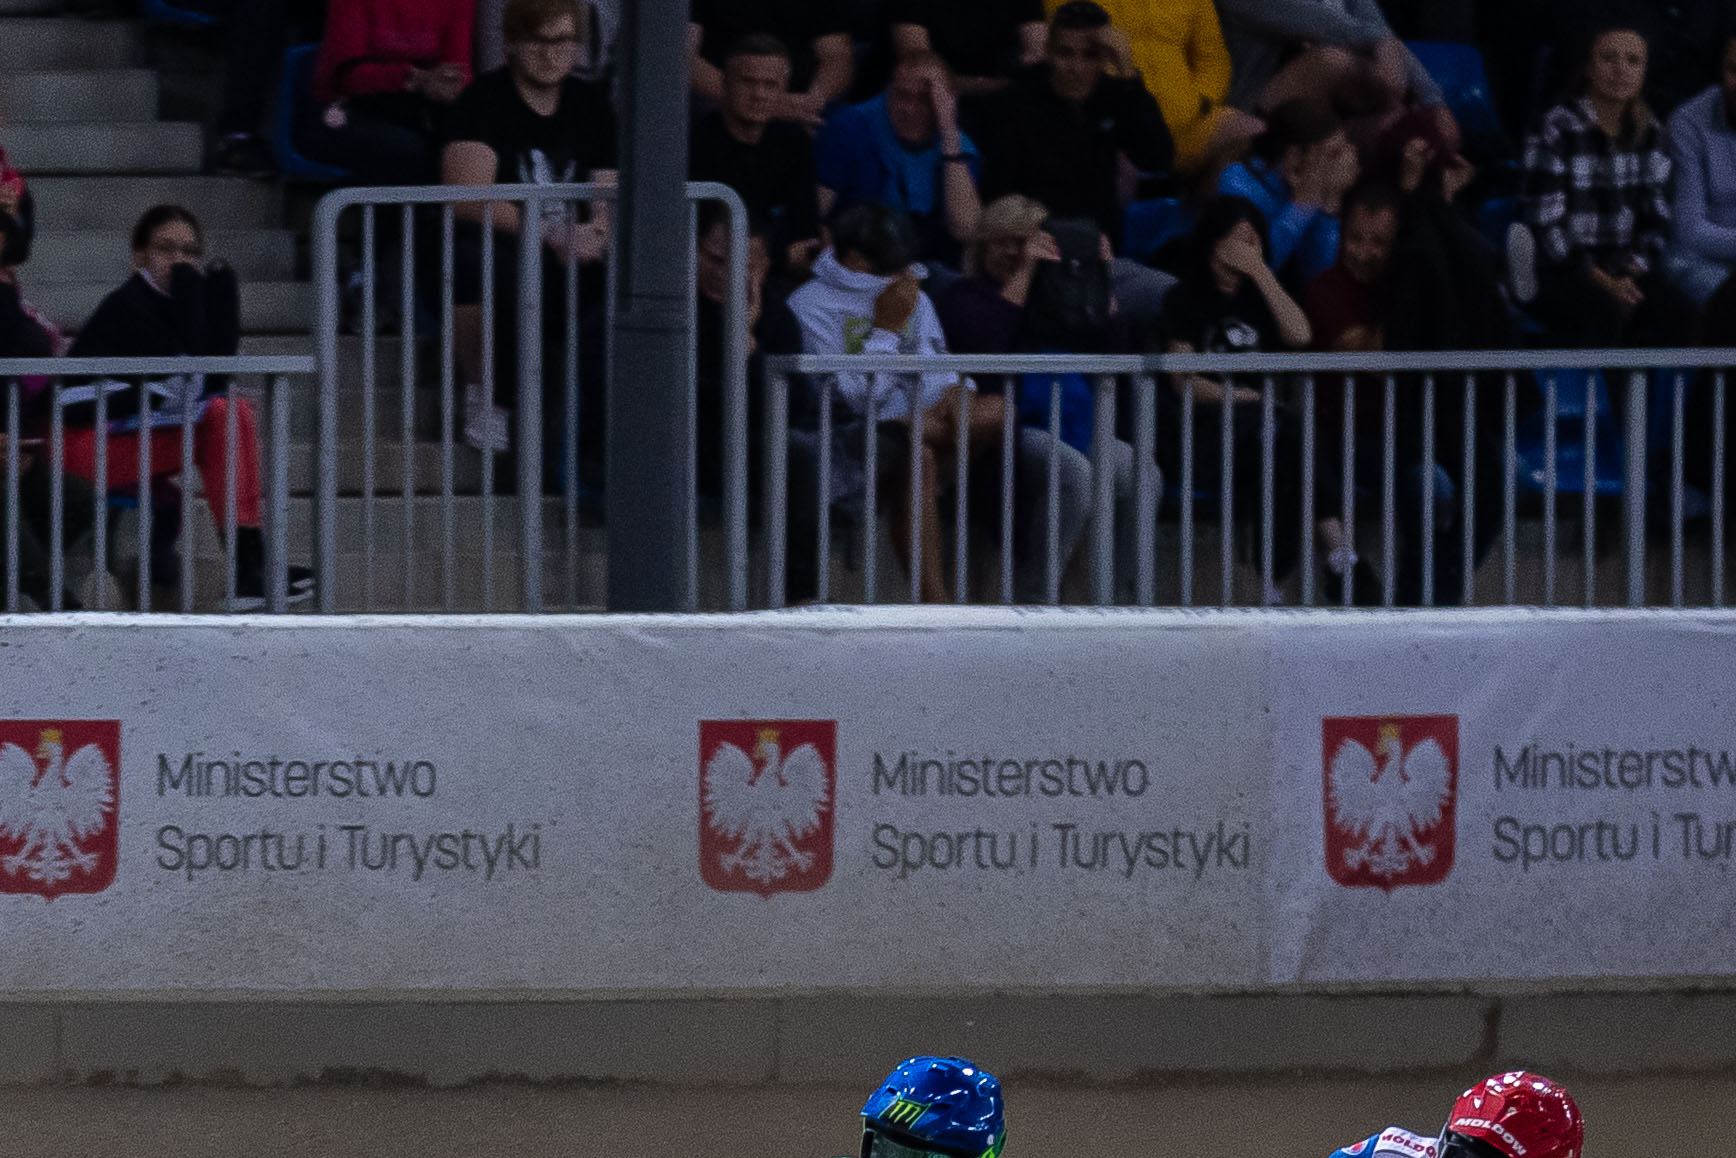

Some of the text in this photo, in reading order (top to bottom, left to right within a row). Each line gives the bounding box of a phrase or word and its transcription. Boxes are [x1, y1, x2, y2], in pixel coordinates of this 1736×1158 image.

[156, 752, 437, 798] Ministerstwo
[872, 751, 1149, 798] Ministerstwo
[1492, 745, 1736, 792] Ministerstw
[156, 824, 541, 881] Sportu i Turystyki
[872, 822, 1251, 880] Sportu i Turystyki
[1492, 812, 1736, 871] Sportu i Tur
[1454, 1117, 1528, 1157] MOLDOW
